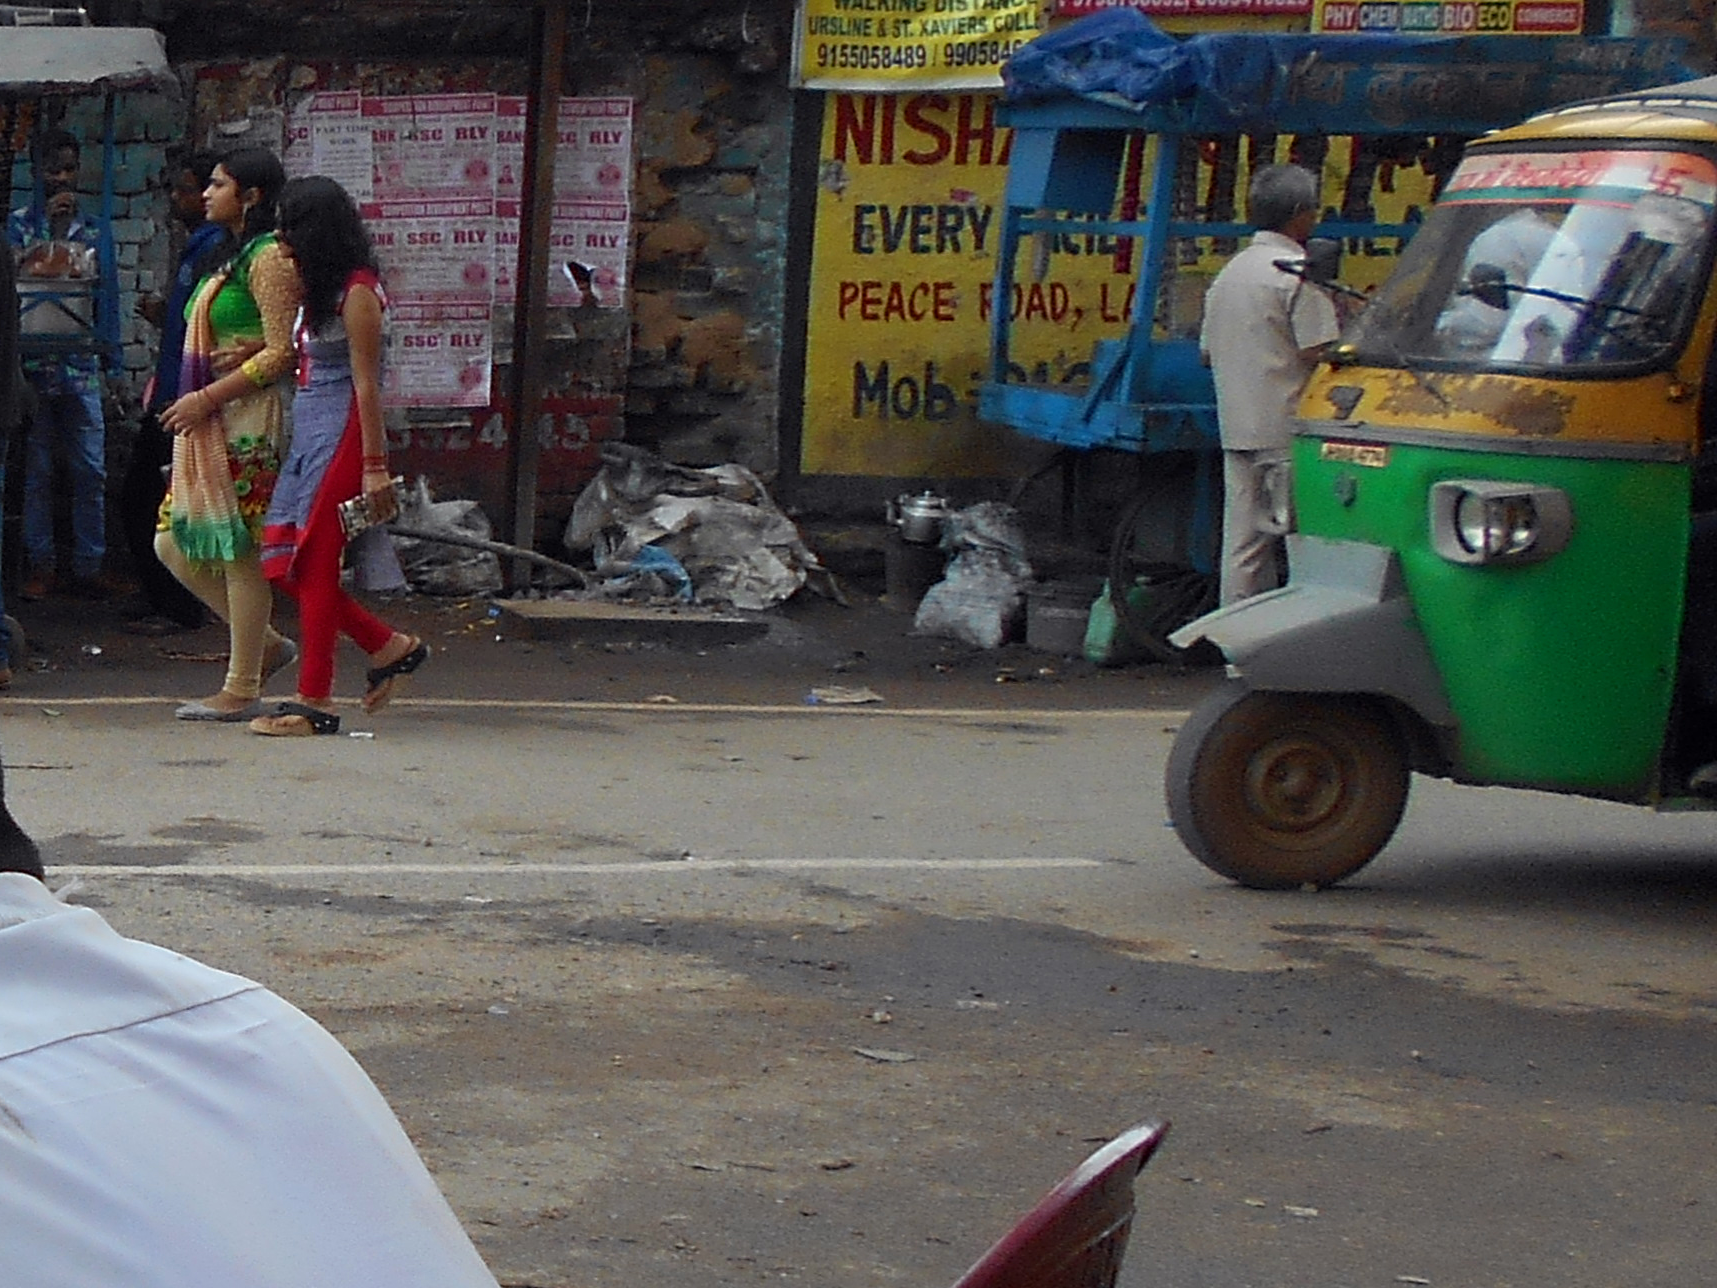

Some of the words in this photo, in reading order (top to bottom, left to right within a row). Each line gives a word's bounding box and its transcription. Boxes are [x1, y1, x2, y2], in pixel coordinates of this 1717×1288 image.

[919, 16, 988, 37] XAVIERS
[1324, 3, 1356, 29] PHY
[1443, 3, 1474, 28] BIO
[1479, 3, 1510, 28] ECO
[817, 42, 927, 69] 9155058489
[853, 204, 993, 255] EVERY
[839, 281, 956, 322] PEACE
[403, 334, 439, 348] SSC
[449, 333, 485, 347] RLY
